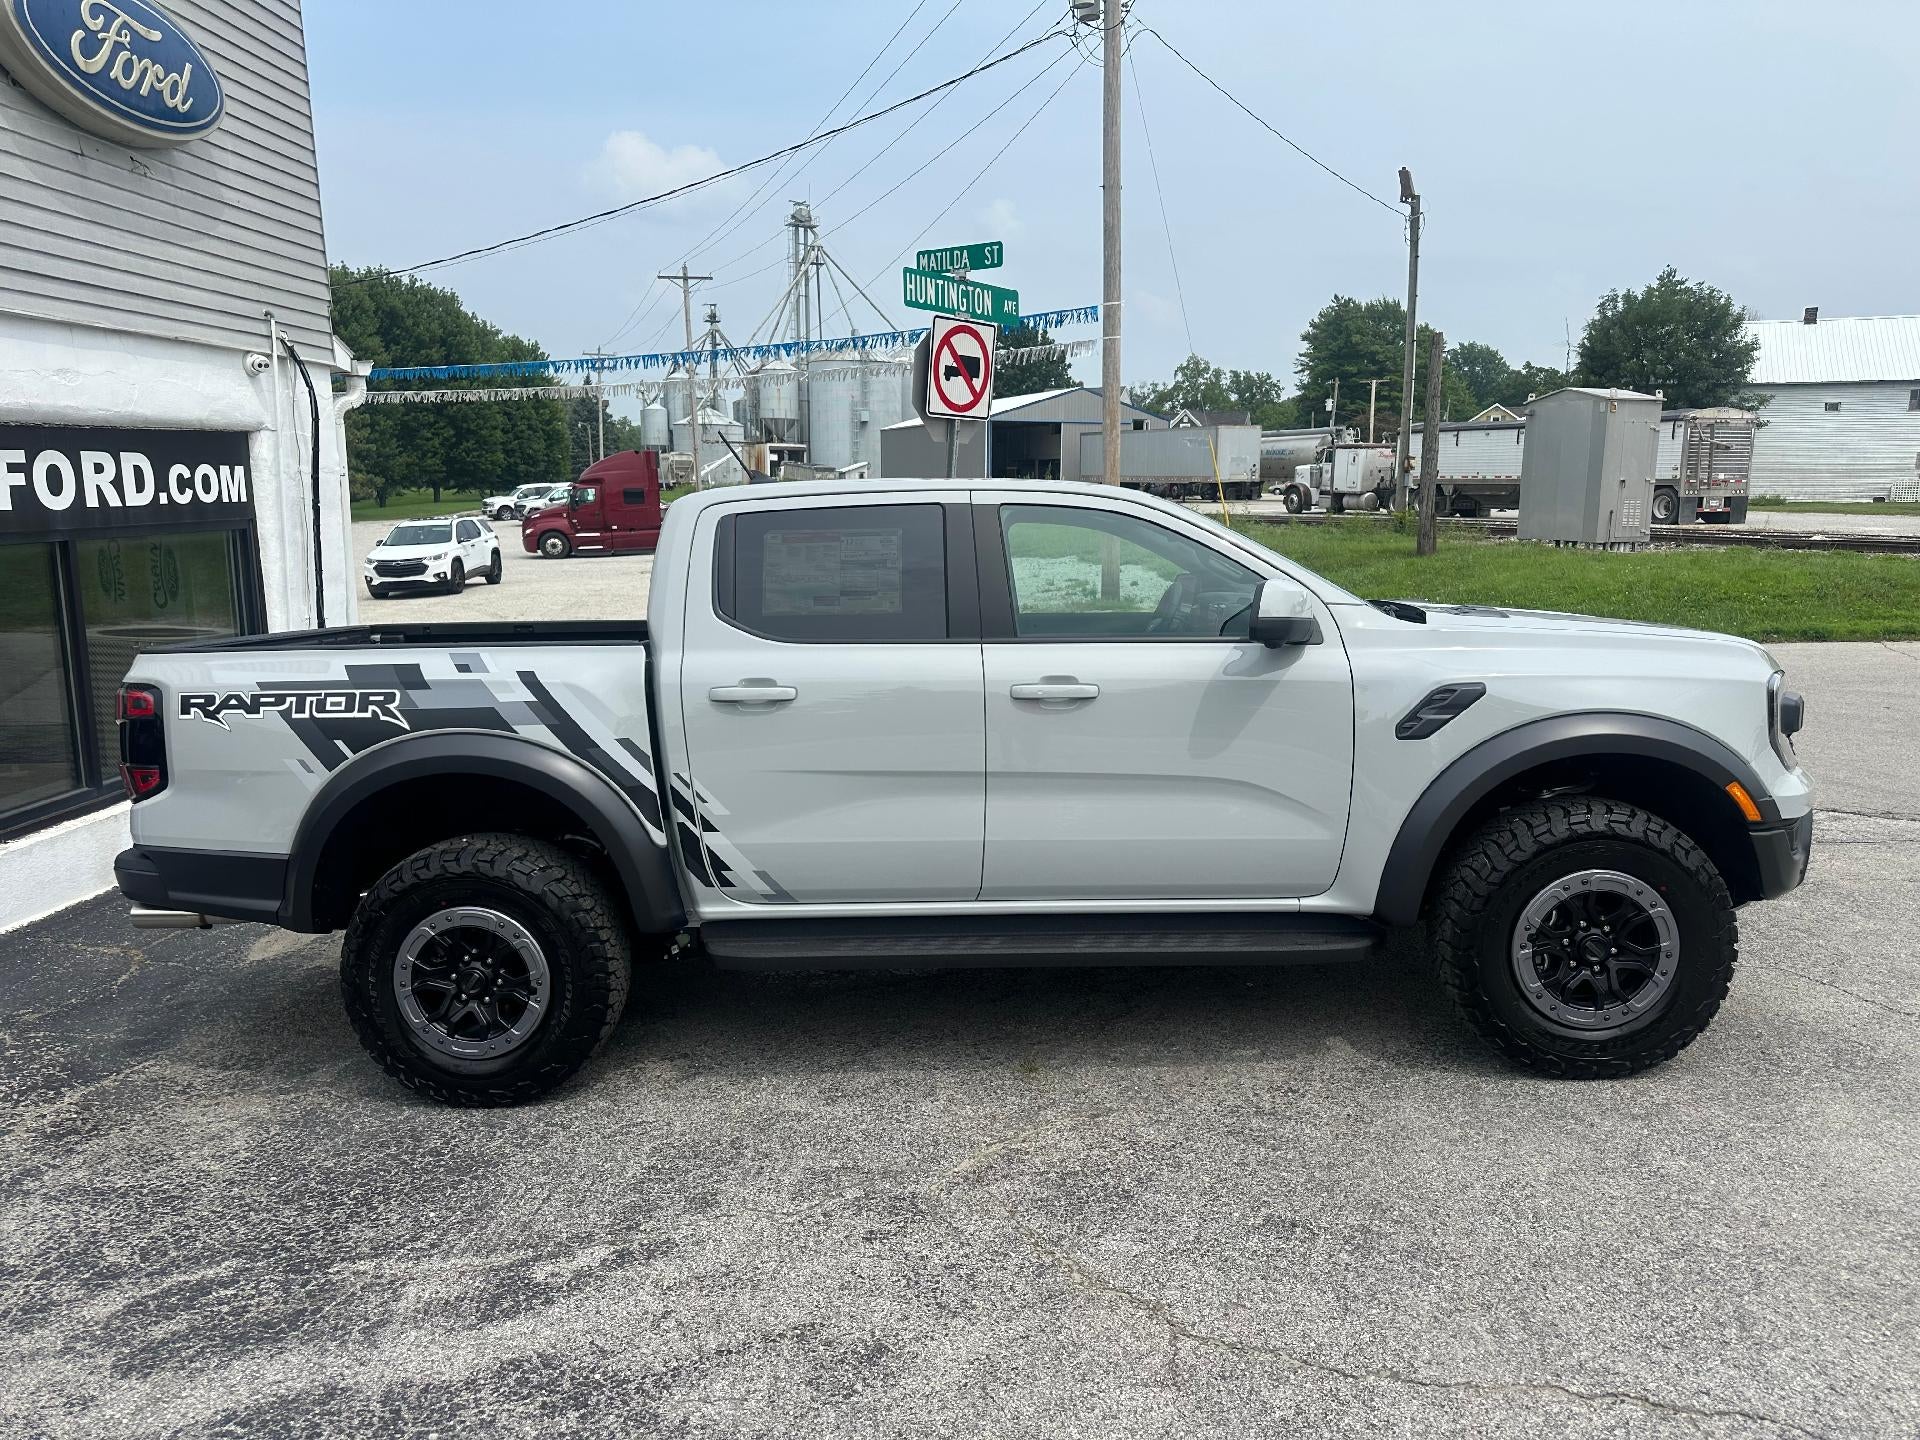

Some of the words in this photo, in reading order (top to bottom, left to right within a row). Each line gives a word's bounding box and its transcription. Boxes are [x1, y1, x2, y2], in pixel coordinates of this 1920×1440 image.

[71, 0, 194, 113] Ford
[919, 249, 970, 271] MATILDA
[984, 245, 1000, 265] ST
[906, 272, 993, 317] HUNTINGTON
[1003, 300, 1017, 315] AVE
[178, 689, 412, 731] RAPTOR
